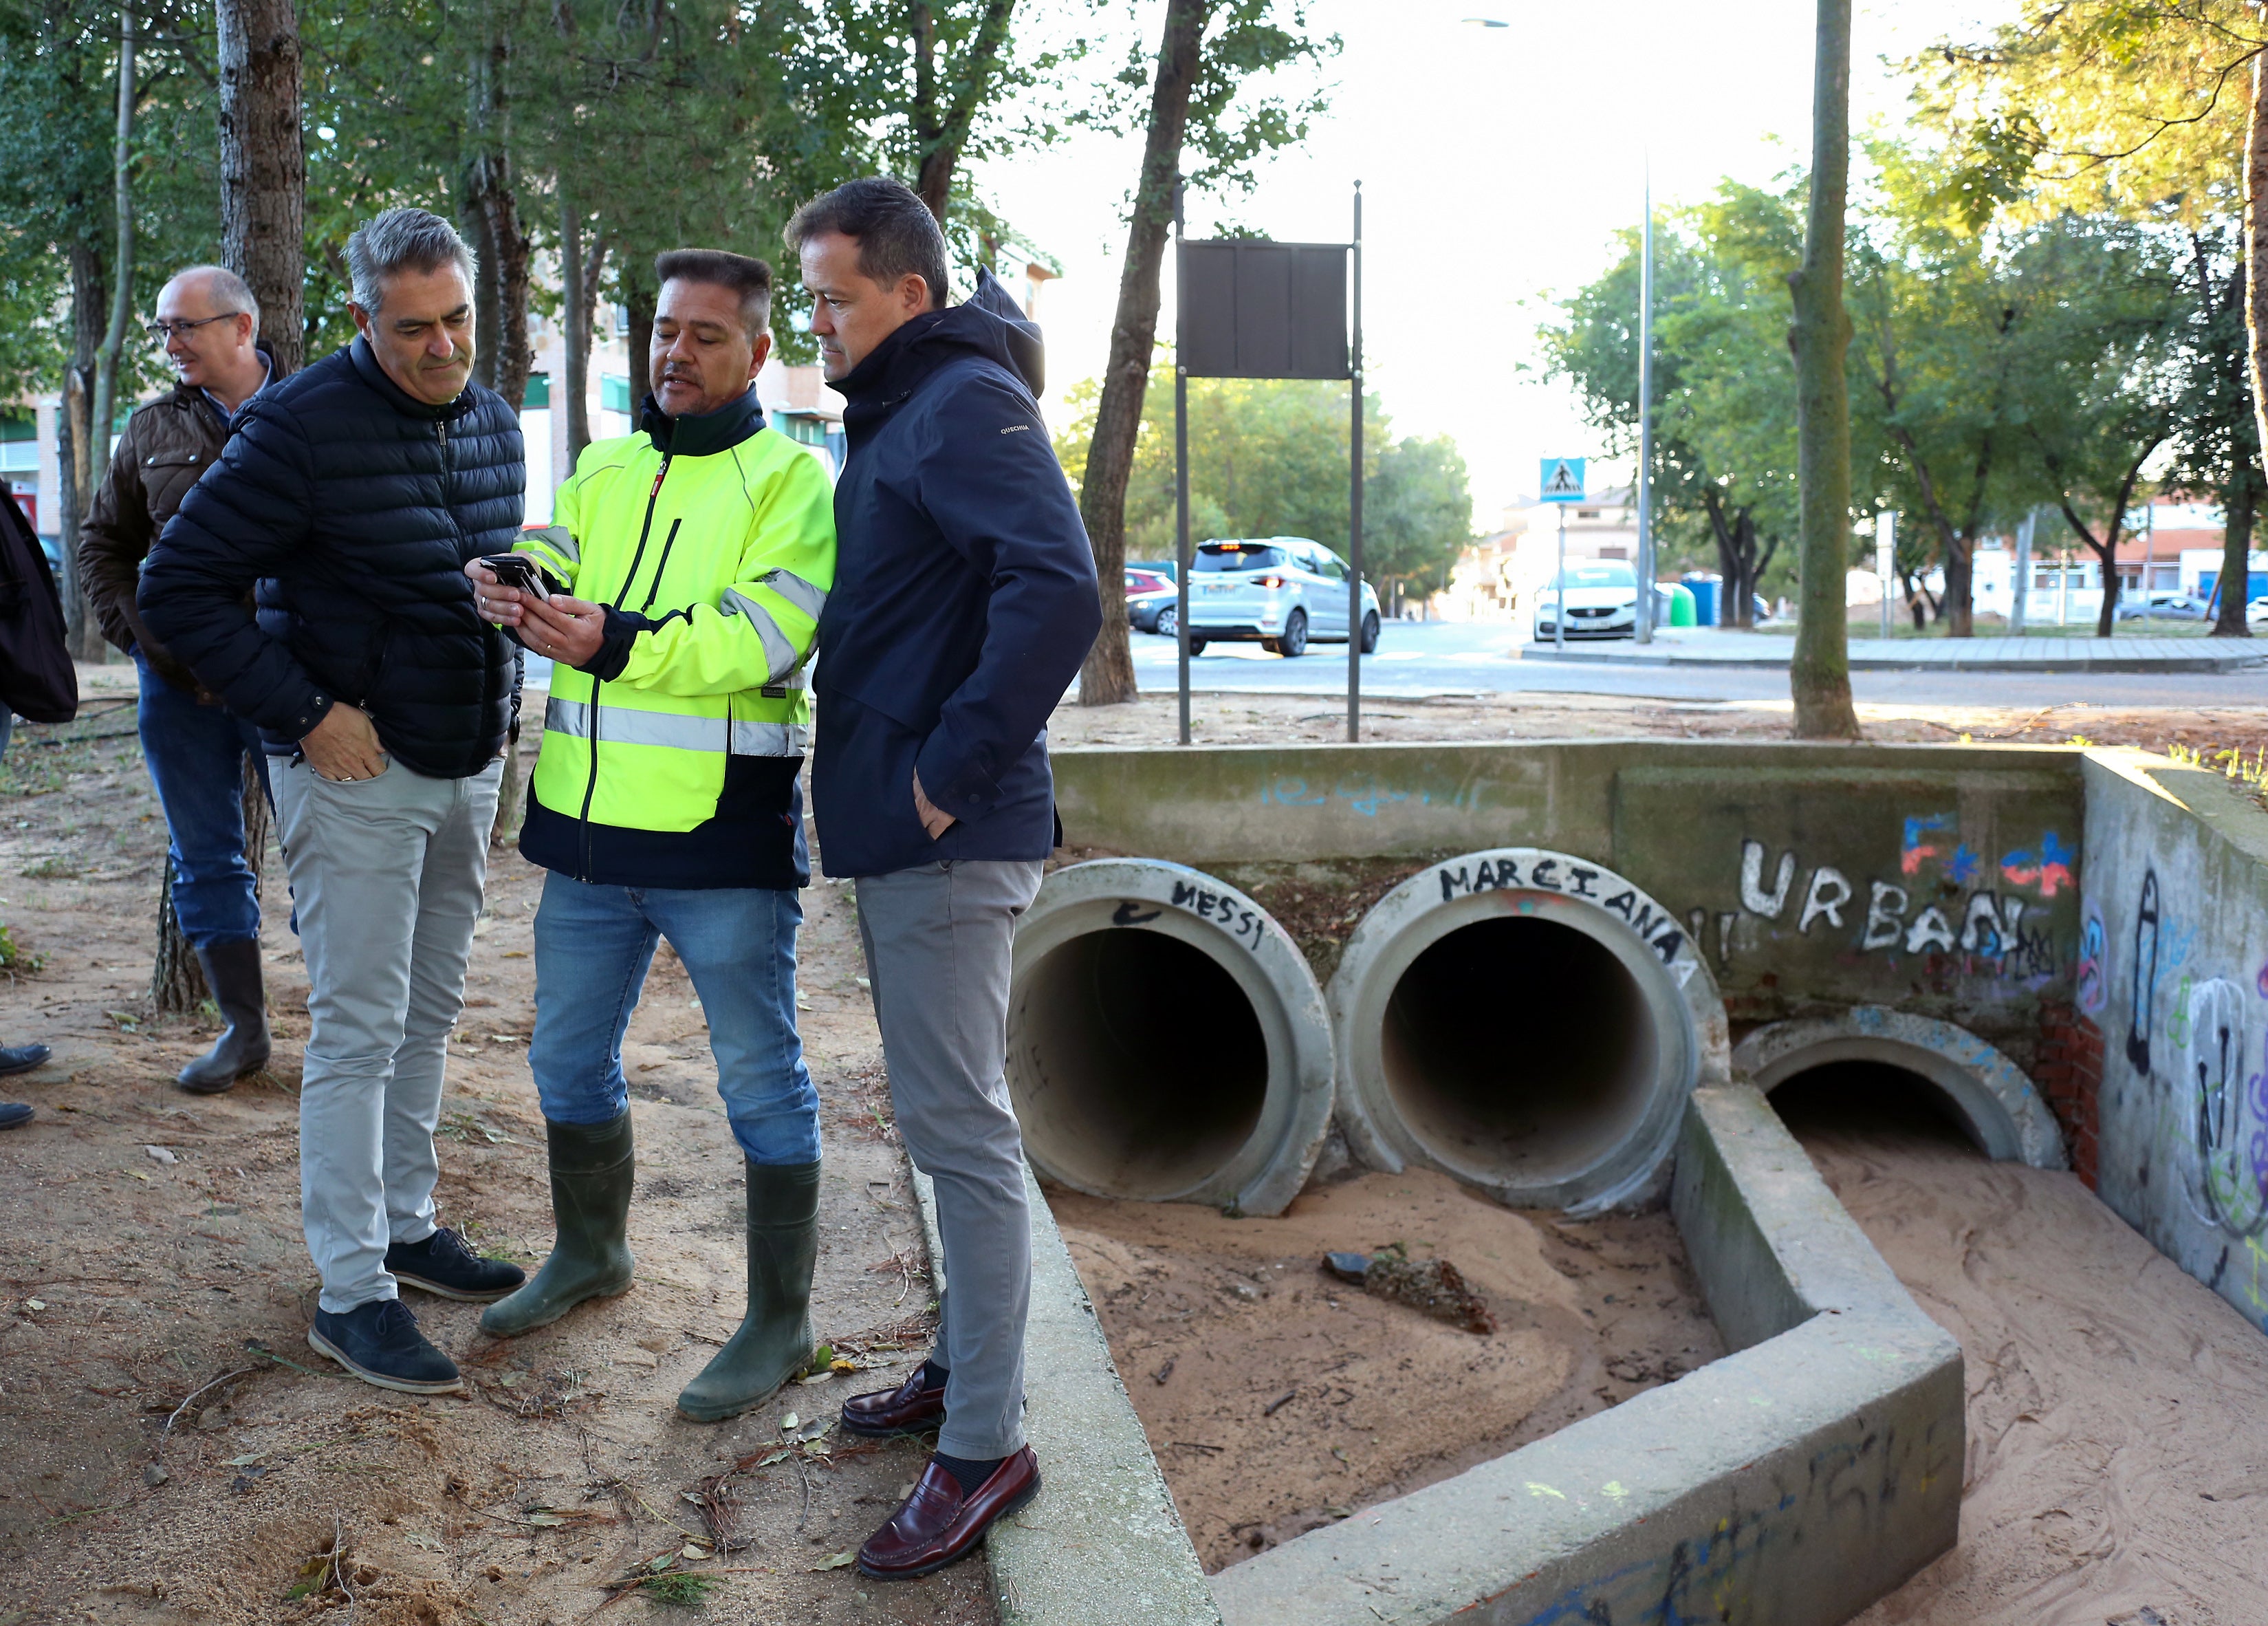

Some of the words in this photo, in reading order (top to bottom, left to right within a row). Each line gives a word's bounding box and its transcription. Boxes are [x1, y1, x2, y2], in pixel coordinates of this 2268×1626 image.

[1001, 424, 1029, 435] QUECHUA
[1439, 858, 1684, 964] MARCIANA
[1741, 838, 2025, 955] URBAN
